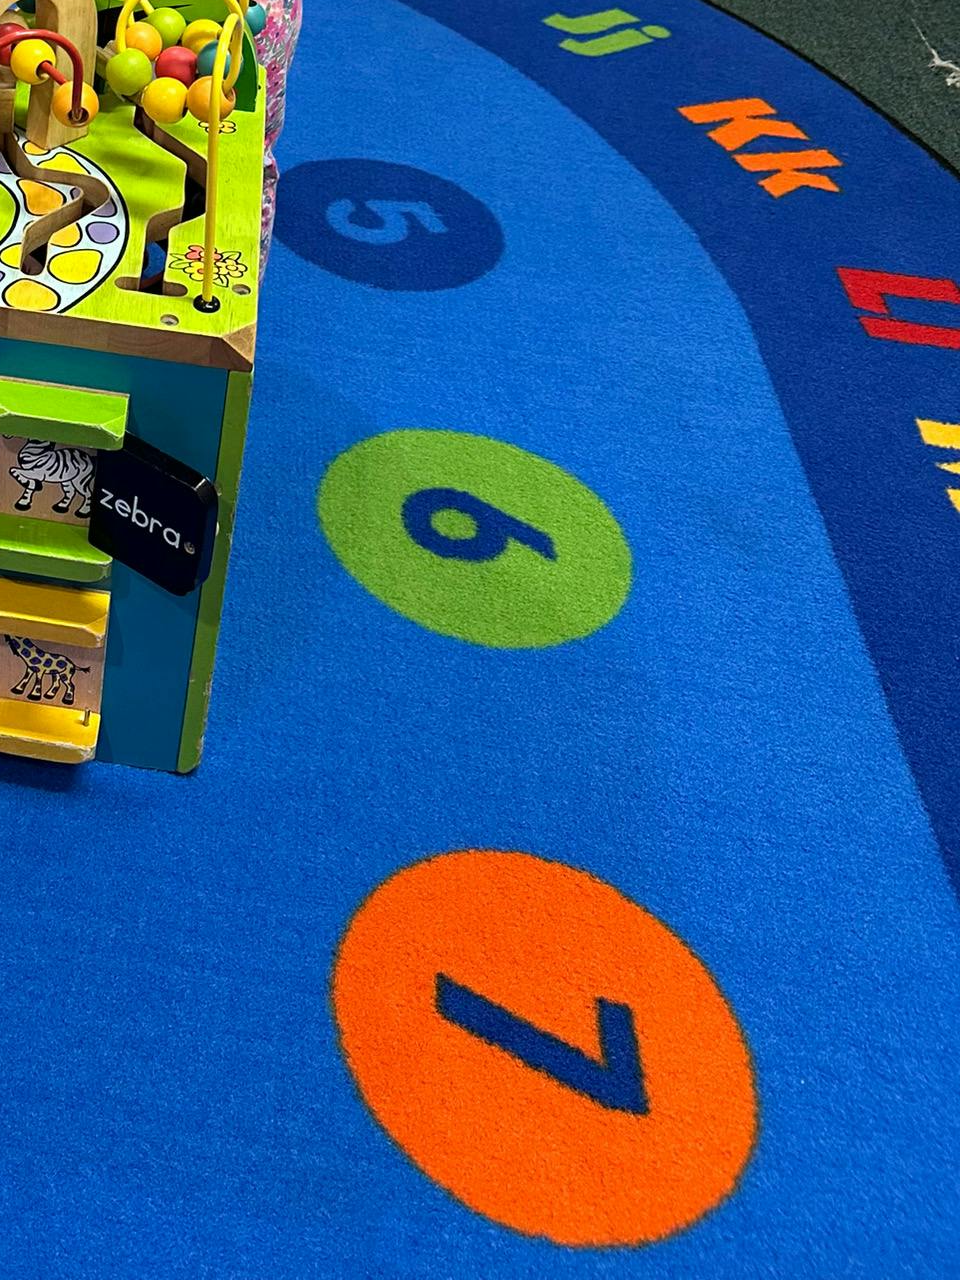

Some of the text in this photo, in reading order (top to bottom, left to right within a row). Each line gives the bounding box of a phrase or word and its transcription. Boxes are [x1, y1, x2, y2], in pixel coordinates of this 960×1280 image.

[543, 8, 671, 56] Jj
[327, 198, 448, 244] 5
[100, 486, 181, 551] zebra
[435, 972, 649, 1115] 7
